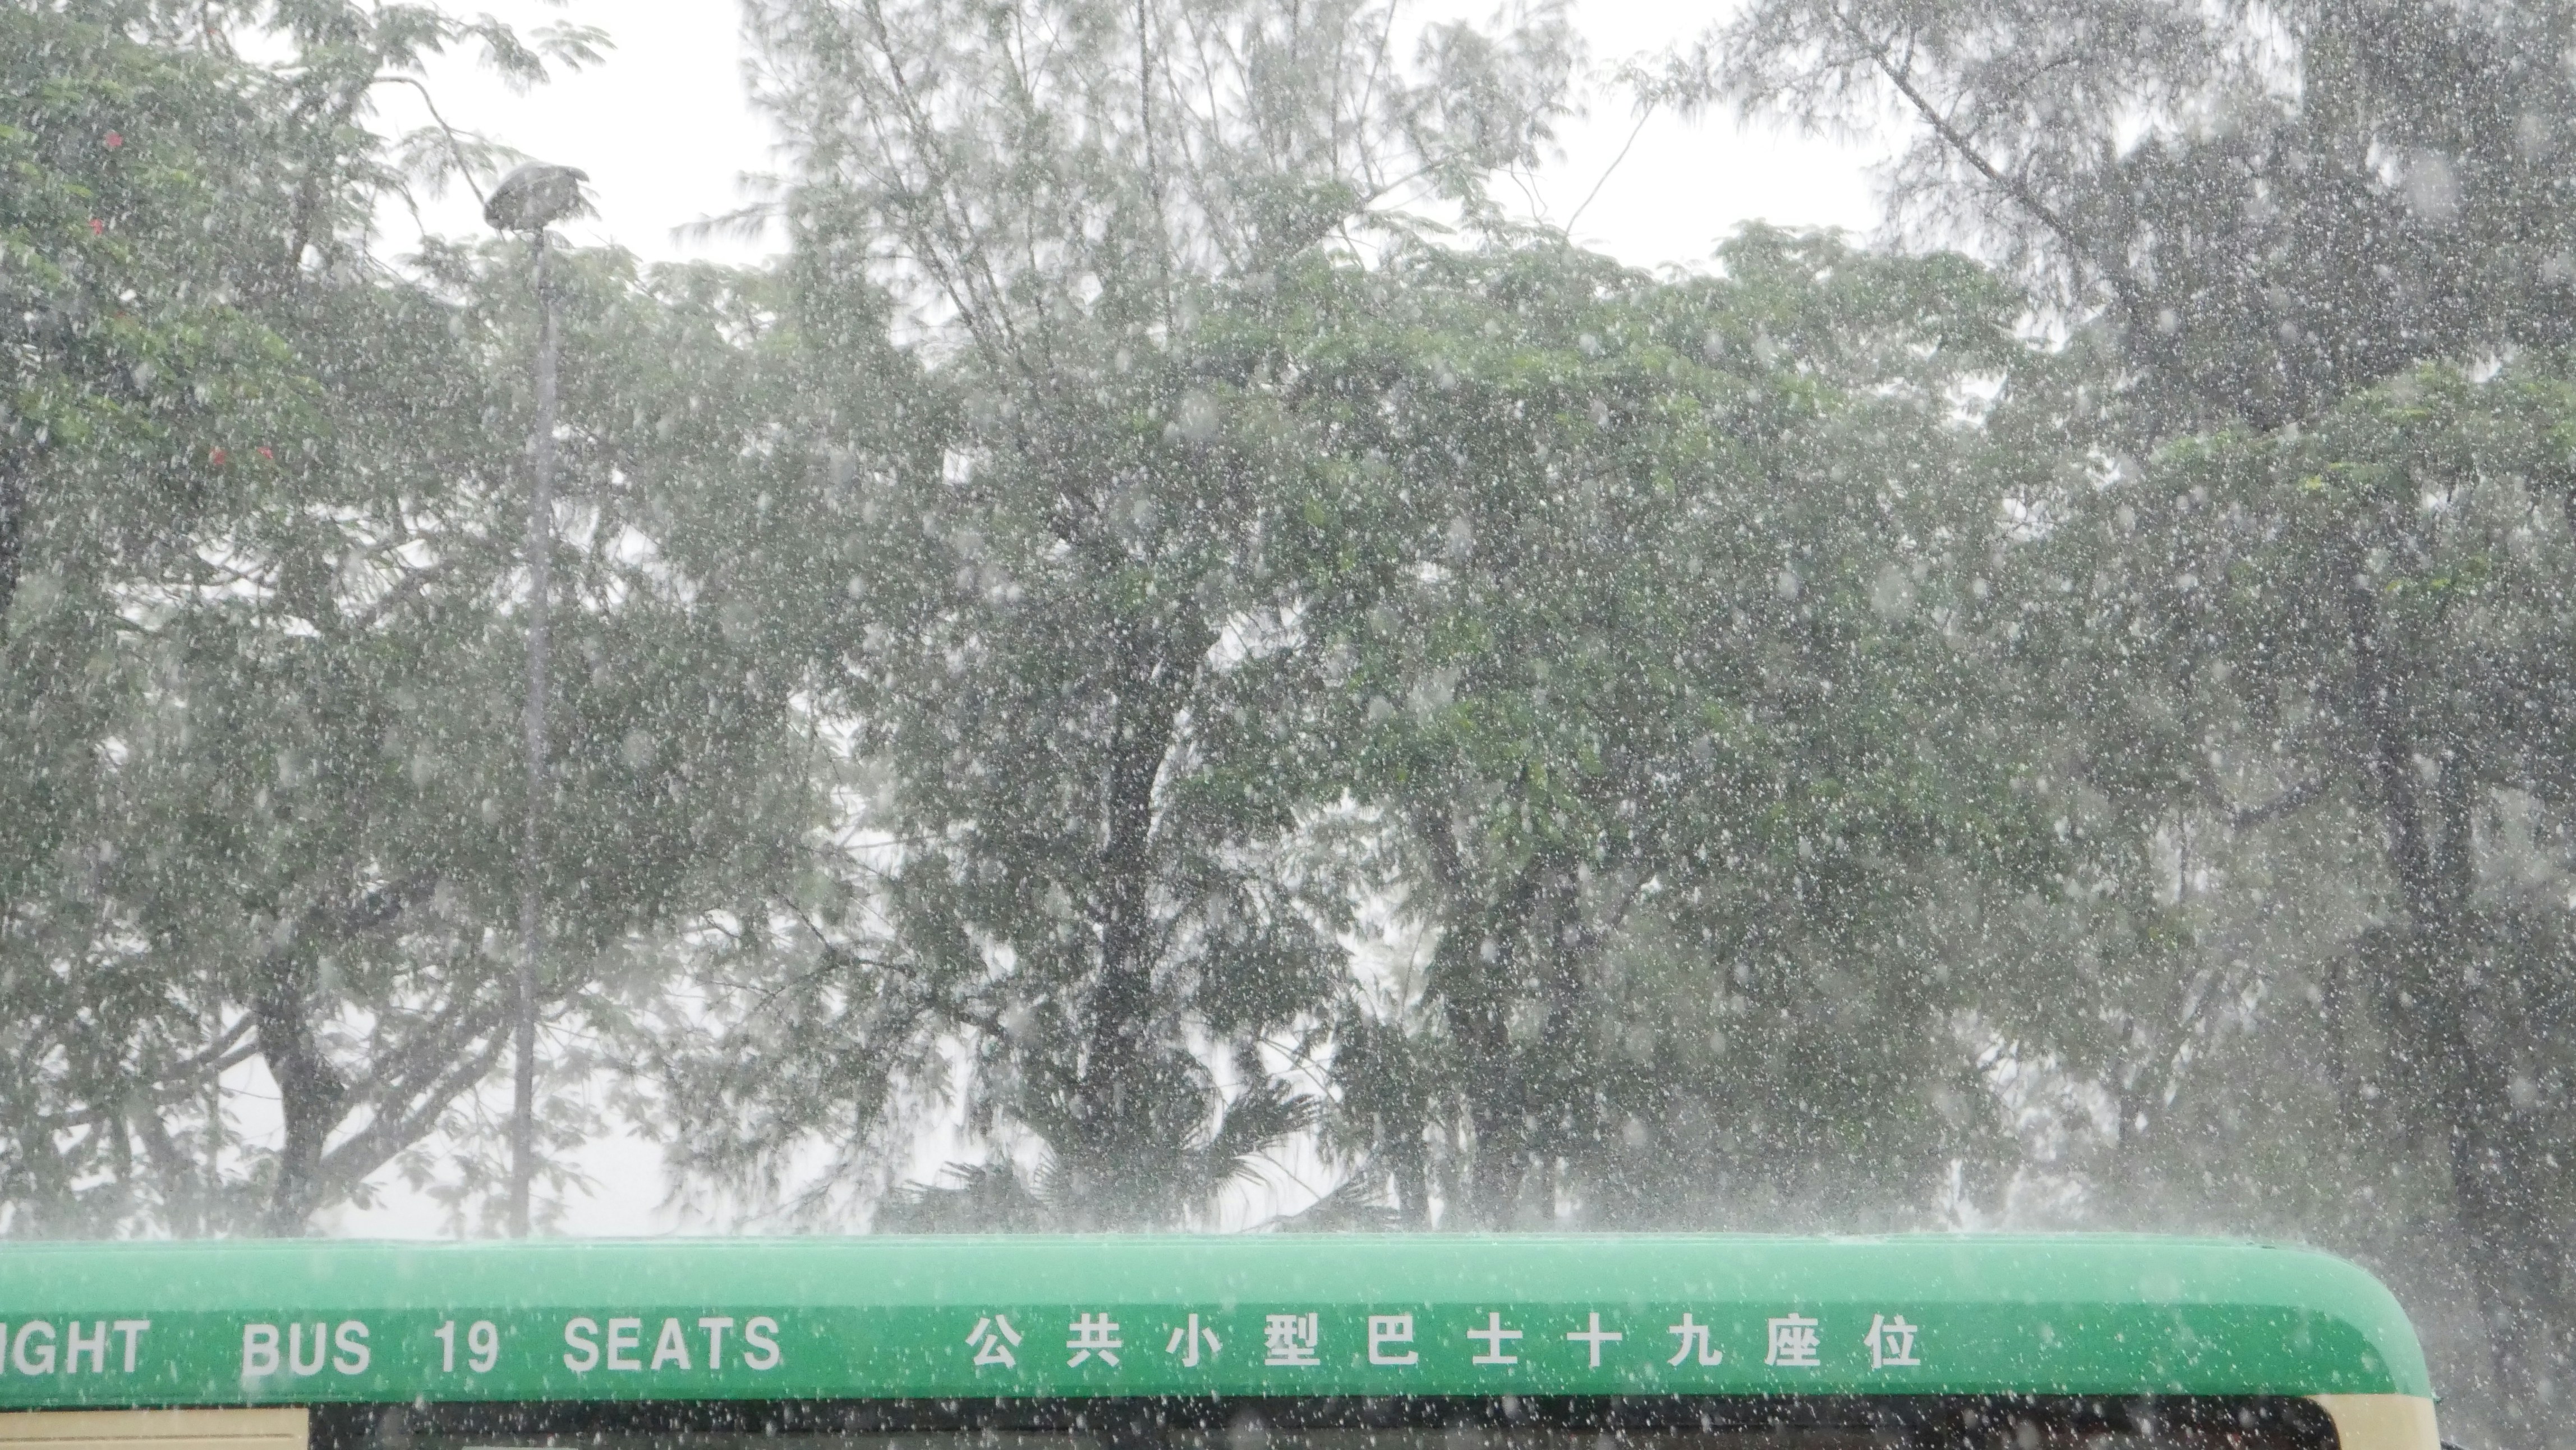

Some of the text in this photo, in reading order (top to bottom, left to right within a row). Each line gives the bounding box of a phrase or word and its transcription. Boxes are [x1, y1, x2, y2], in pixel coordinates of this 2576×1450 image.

[242, 1320, 371, 1376] BUS
[434, 1320, 499, 1373] 19
[563, 1316, 781, 1371] SEATS
[965, 1312, 1921, 1369] 公共小型巴士十九座位
